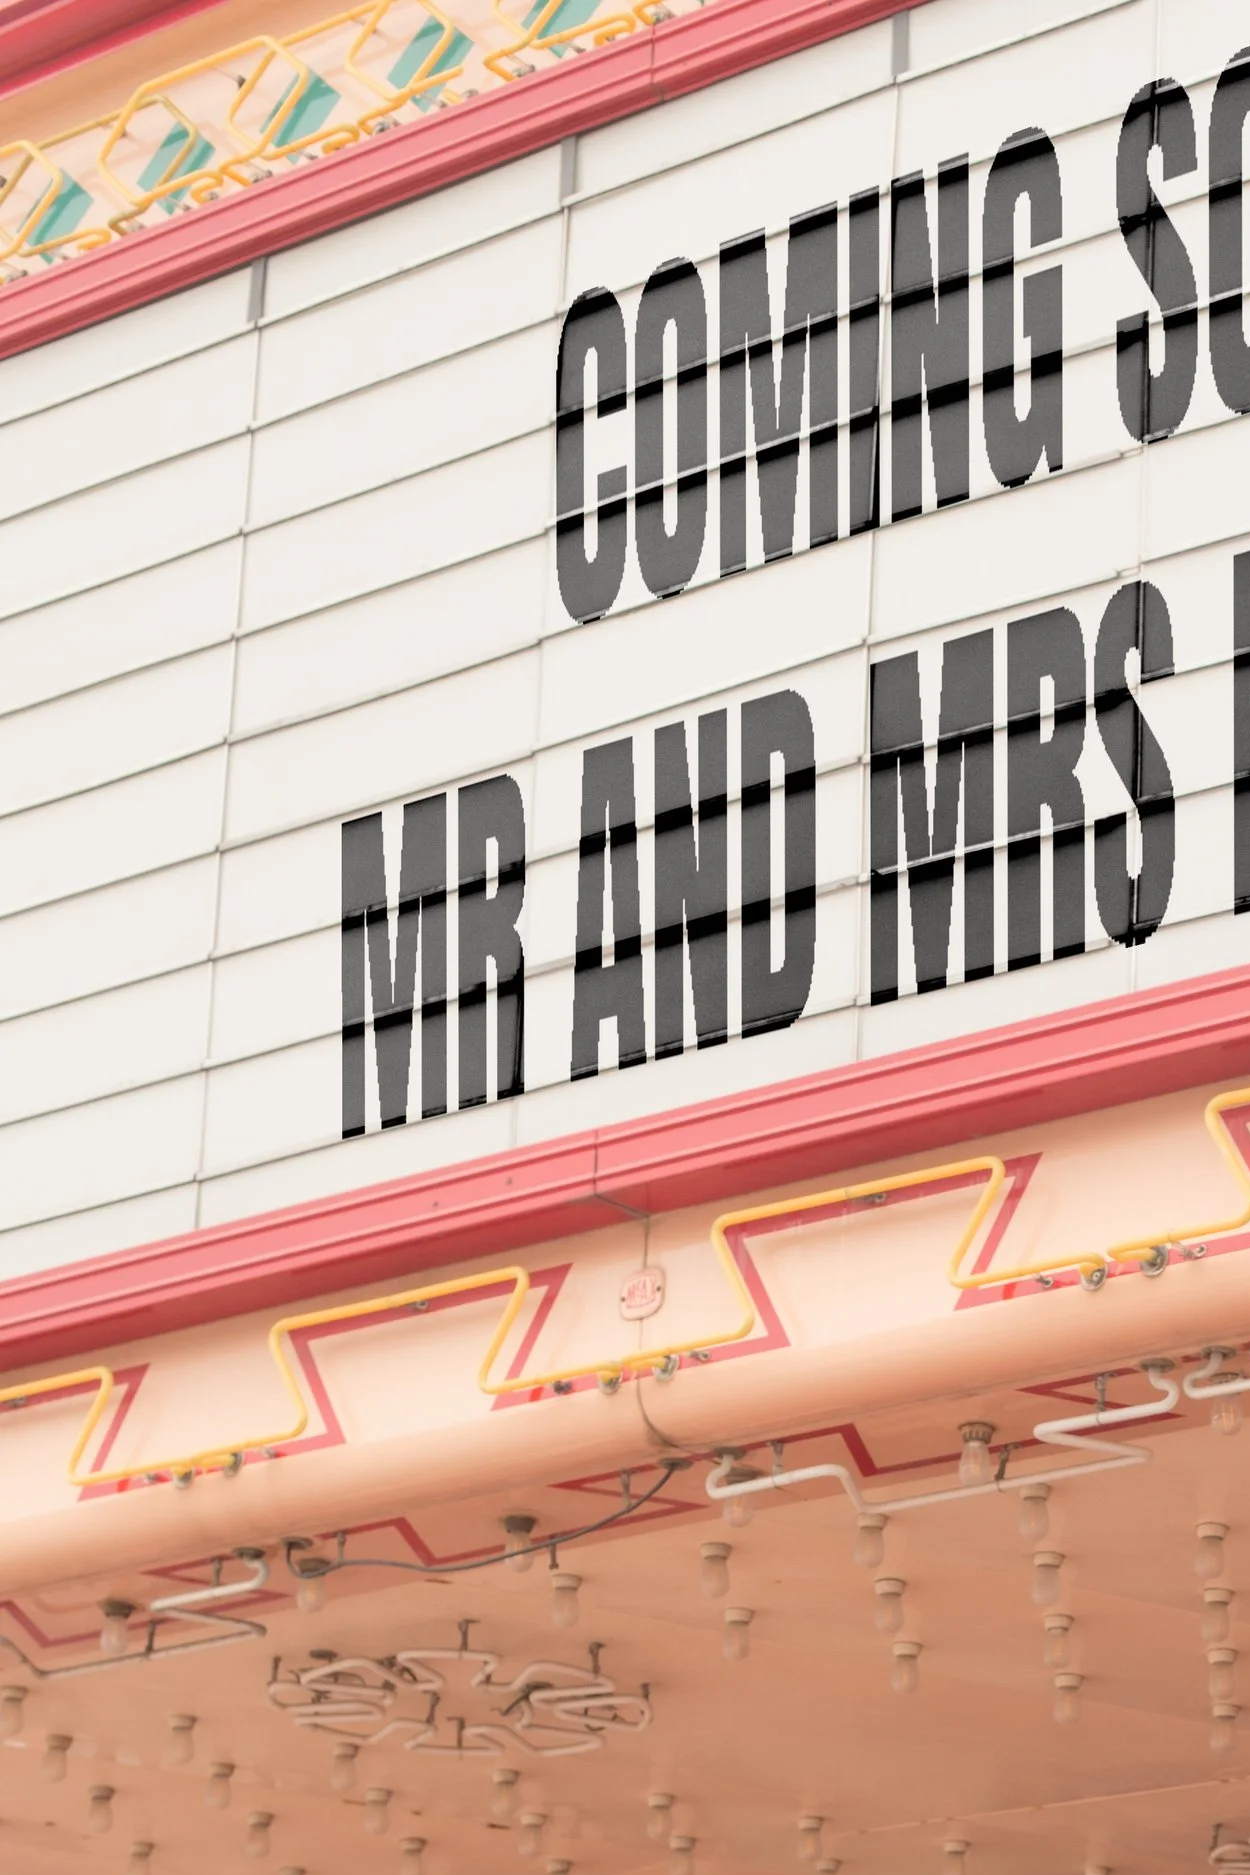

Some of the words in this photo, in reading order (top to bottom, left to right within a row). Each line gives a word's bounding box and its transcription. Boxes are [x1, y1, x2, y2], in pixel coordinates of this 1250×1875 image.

[556, 126, 1064, 625] COMING
[341, 774, 526, 1139] MR
[571, 689, 817, 1081] AND
[870, 580, 1176, 1006] MRS
